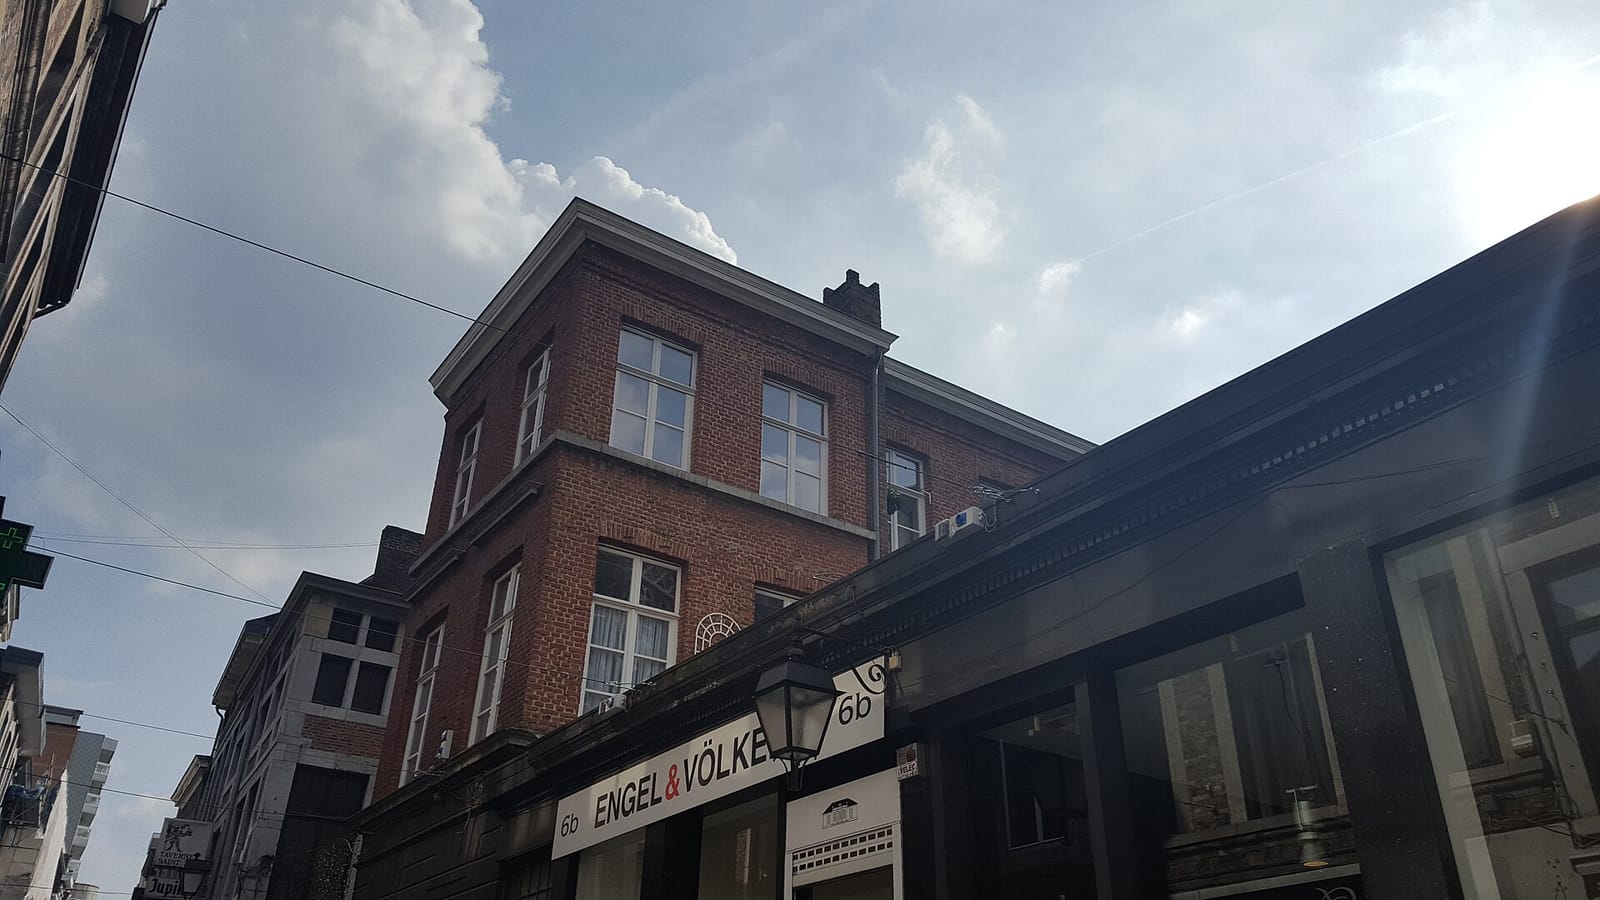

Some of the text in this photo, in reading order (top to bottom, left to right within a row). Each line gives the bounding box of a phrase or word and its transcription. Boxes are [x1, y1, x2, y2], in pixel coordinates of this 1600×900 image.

[838, 692, 872, 725] 6b
[683, 727, 768, 792] VÖLKE
[560, 813, 579, 837] 6b
[148, 878, 182, 897] Jupil
